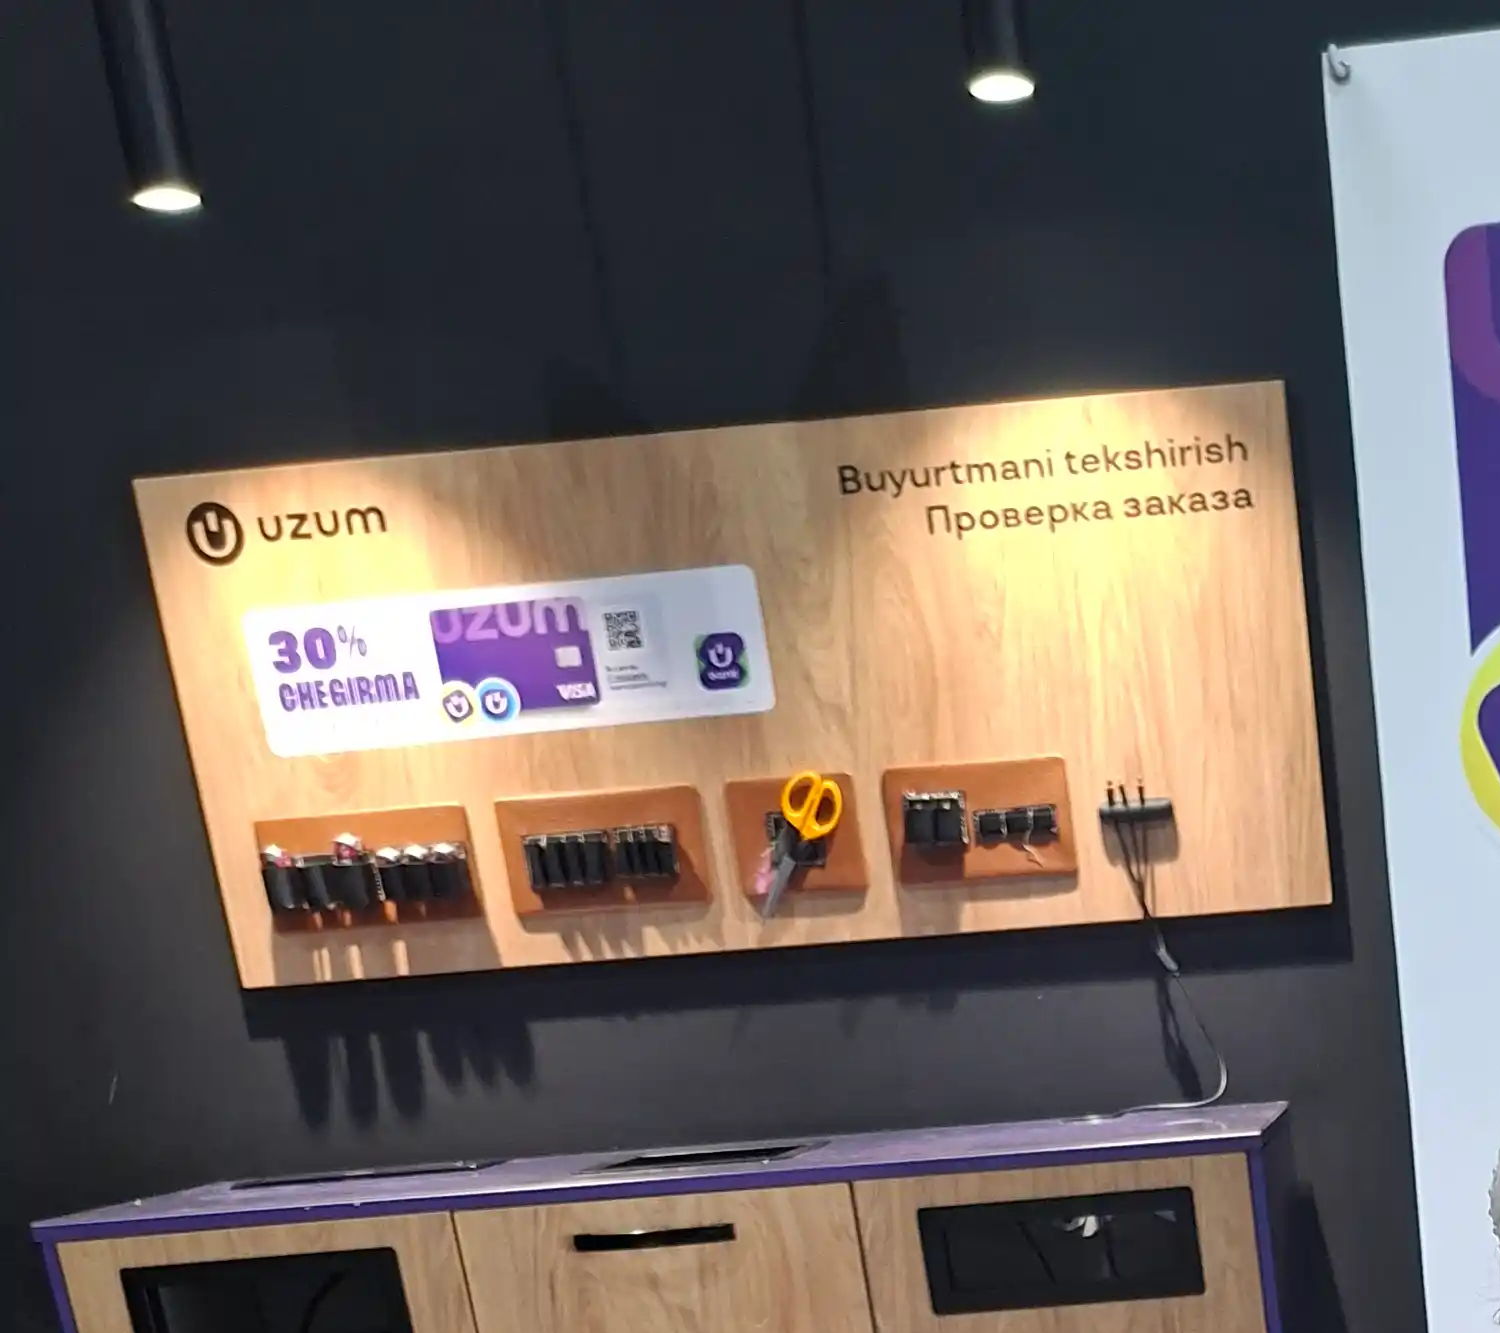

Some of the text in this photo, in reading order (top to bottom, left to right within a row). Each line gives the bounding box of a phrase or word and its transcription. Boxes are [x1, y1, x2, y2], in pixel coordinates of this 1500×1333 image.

[837, 433, 1249, 498] Buyurtmani tekshirish
[925, 484, 1255, 540] Проверка заказа
[268, 614, 367, 674] 30%
[278, 671, 421, 713] CHEGIRMA
[556, 682, 597, 702] VISA
